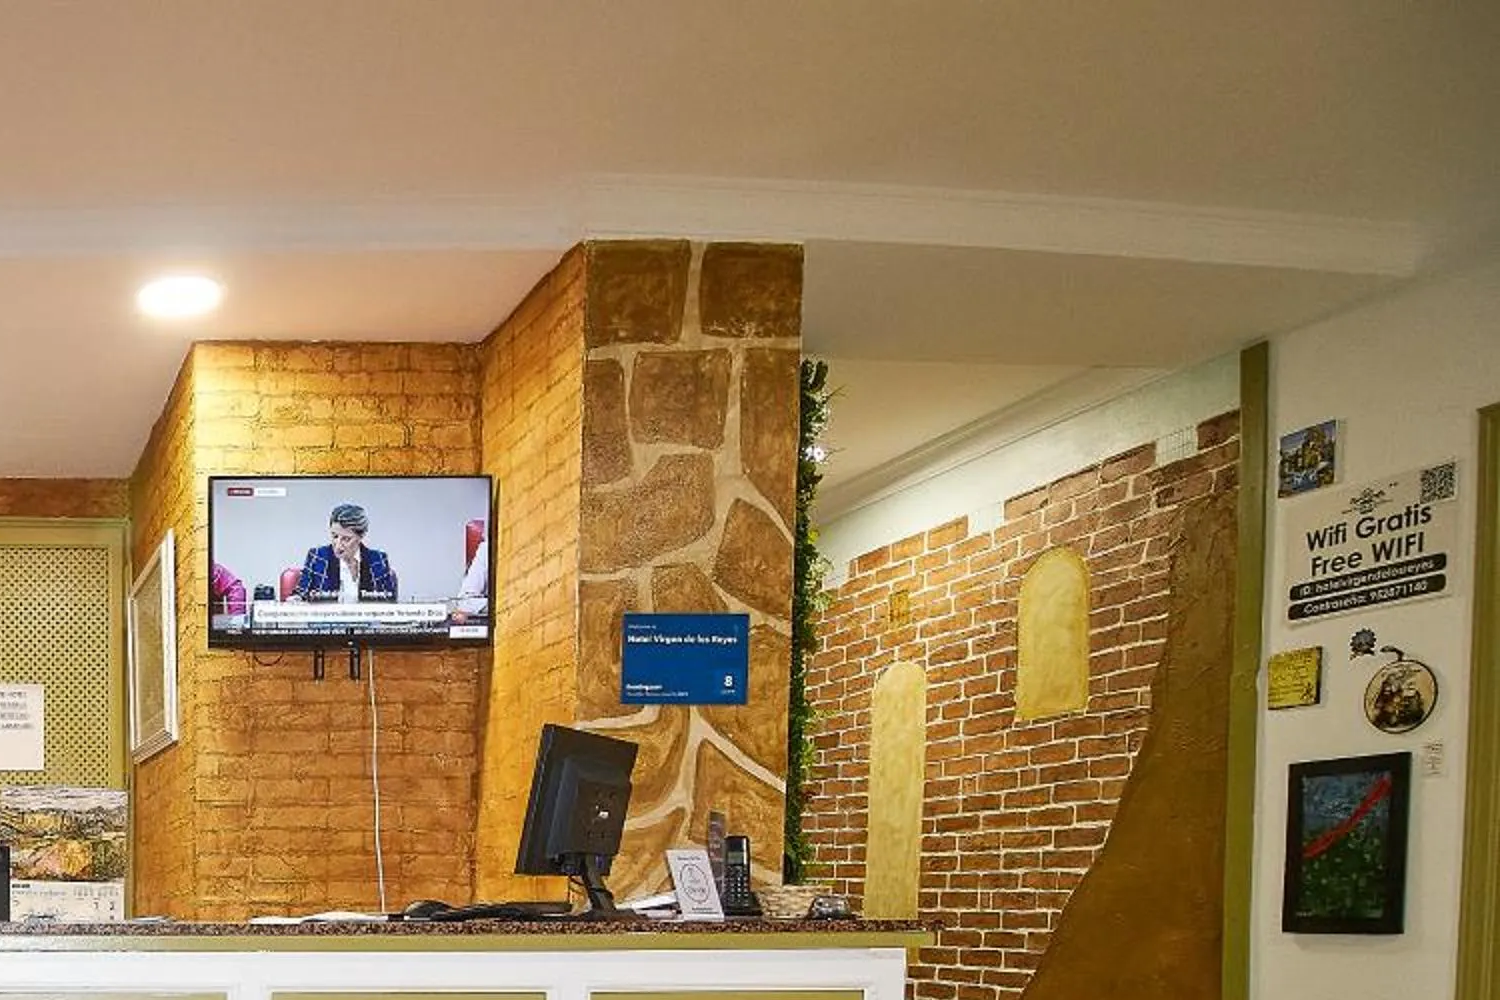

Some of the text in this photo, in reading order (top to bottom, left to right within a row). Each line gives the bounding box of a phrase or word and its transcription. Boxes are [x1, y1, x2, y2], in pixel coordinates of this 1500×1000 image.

[1306, 503, 1432, 551] Wifi Gratis
[1311, 532, 1424, 576] Free WIFI
